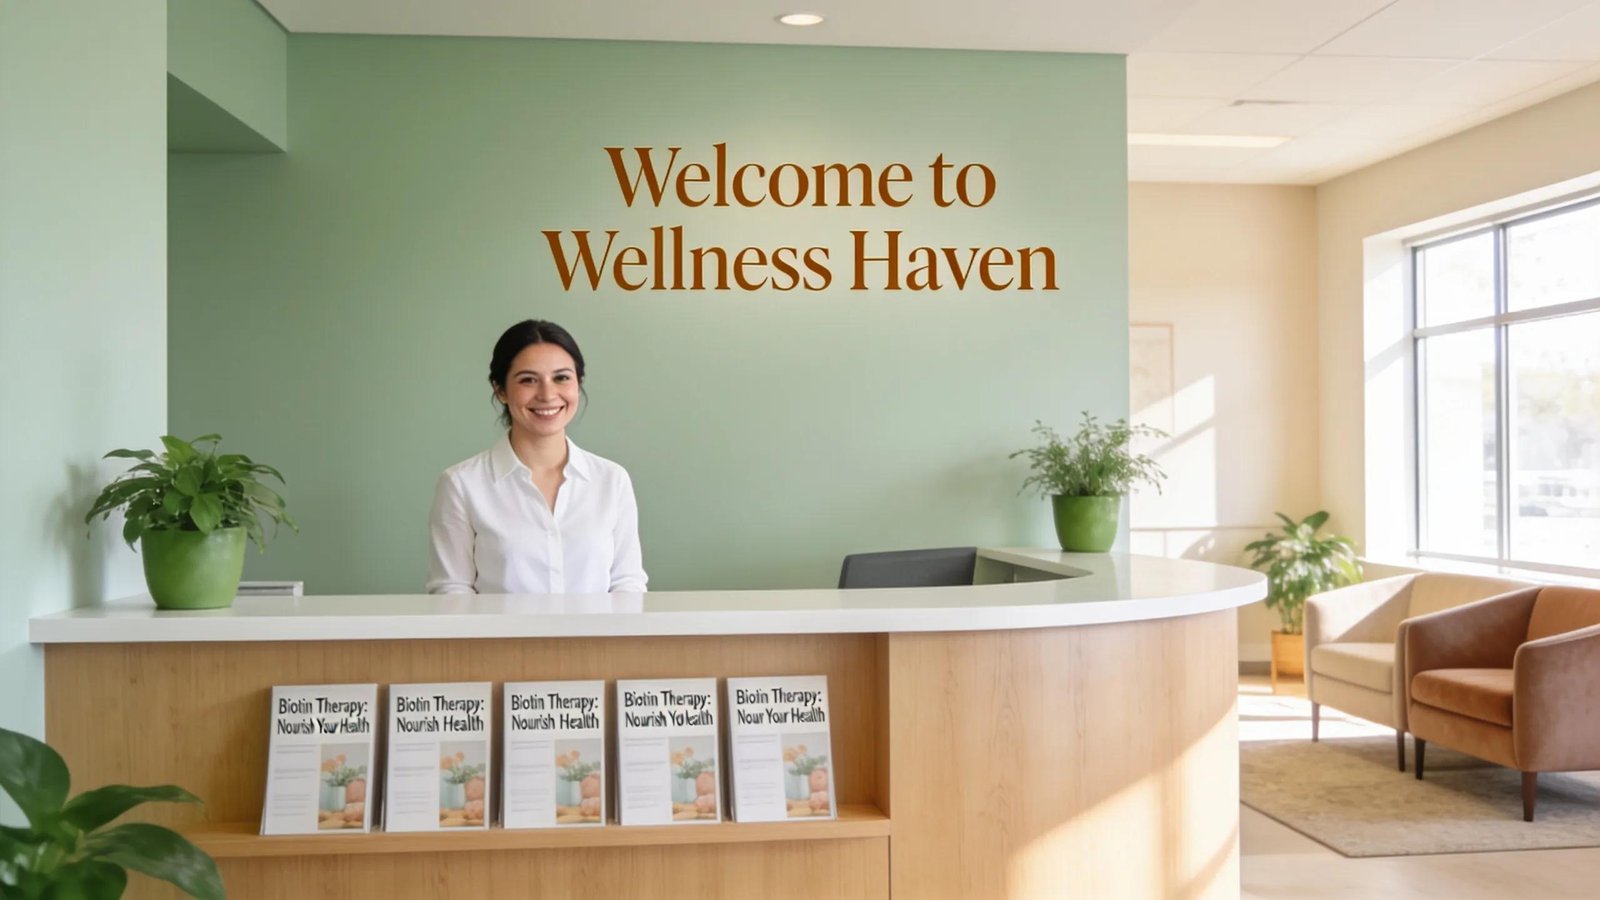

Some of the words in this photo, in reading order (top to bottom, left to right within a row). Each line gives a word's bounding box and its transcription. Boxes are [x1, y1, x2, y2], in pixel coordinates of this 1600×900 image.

[604, 142, 913, 207] Welcome
[929, 152, 996, 207] to
[541, 225, 832, 291] Wellness
[849, 230, 1059, 291] Haven
[433, 695, 484, 715] Therapy:
[511, 694, 545, 711] Biotin
[547, 693, 598, 713] Therapy:
[624, 691, 658, 707] Biotin
[660, 690, 711, 710] Therapy:
[771, 687, 822, 706] Therapy:
[278, 698, 313, 714] Biotin
[315, 697, 368, 717] Therapy:
[397, 716, 439, 733] Nourish
[443, 714, 484, 732] Health
[511, 713, 555, 731] Nourish
[560, 712, 599, 730] Health
[625, 711, 667, 728] Nourish
